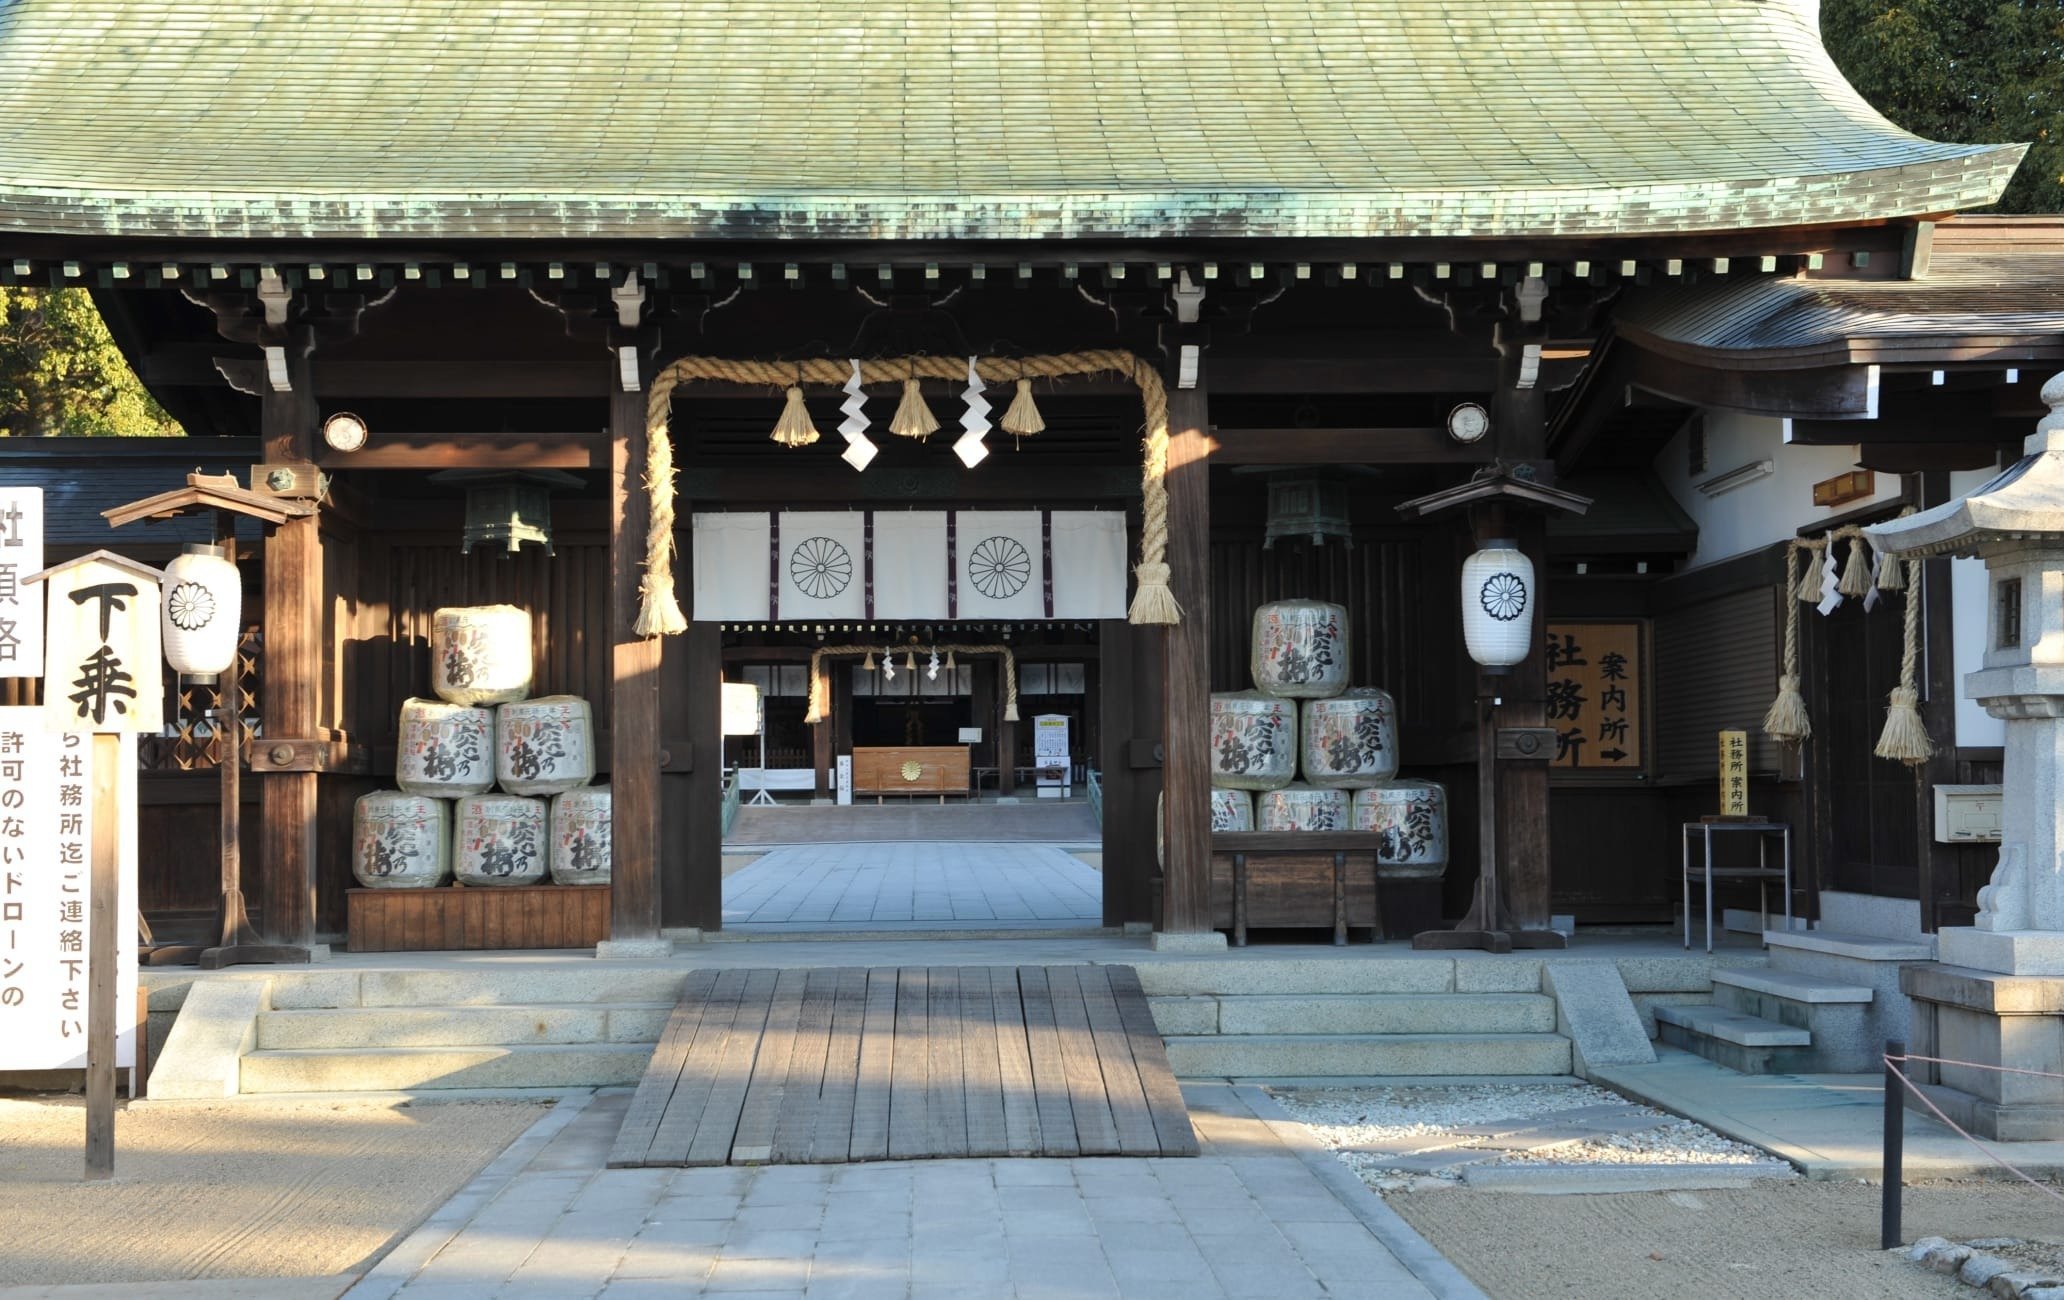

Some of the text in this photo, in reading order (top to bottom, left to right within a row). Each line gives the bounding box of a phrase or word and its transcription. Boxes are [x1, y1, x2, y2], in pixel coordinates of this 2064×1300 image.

[68, 582, 138, 725] 下乗
[1598, 651, 1631, 746] 案内所
[1729, 737, 1744, 813] 社務所 案内所
[2, 732, 25, 1007] 許可のないドローンの
[60, 732, 83, 1038] ら社務所迄ご連絡下さい
